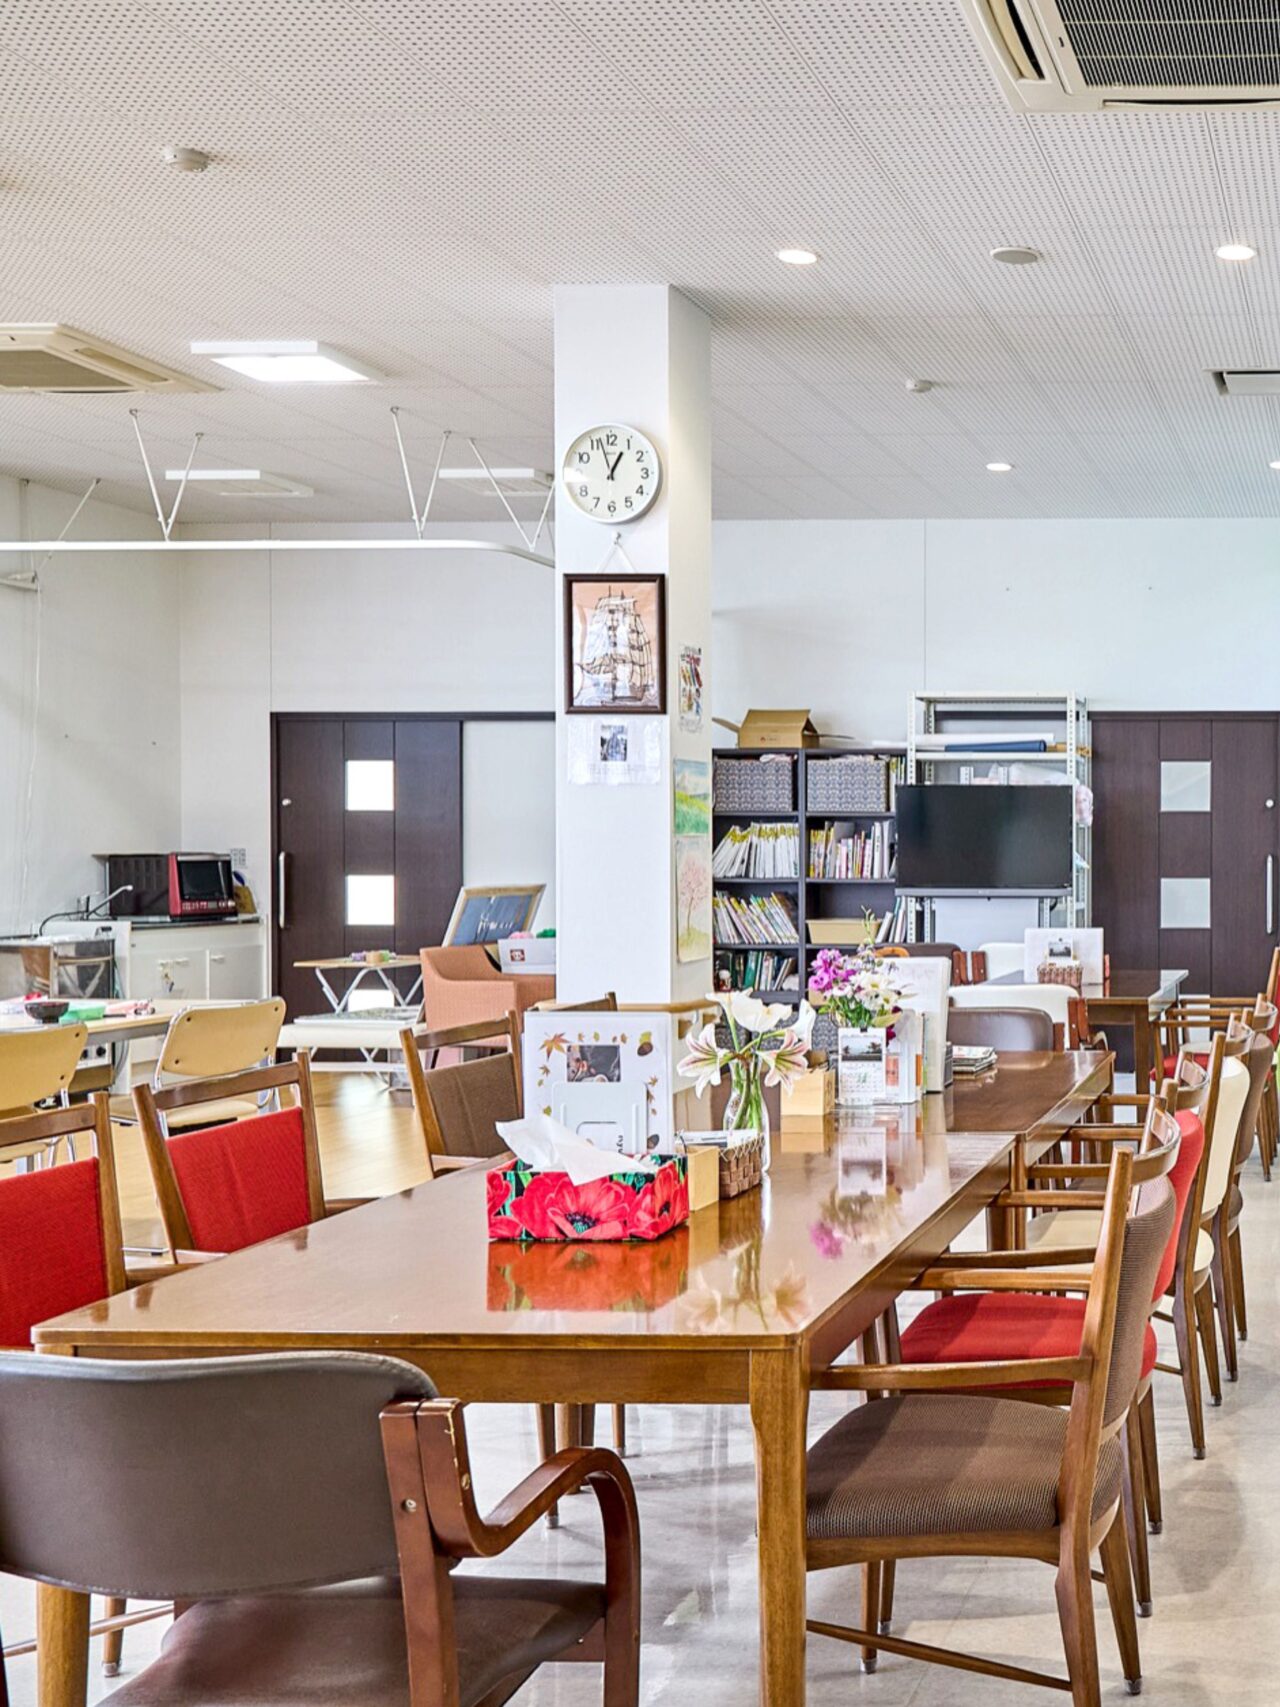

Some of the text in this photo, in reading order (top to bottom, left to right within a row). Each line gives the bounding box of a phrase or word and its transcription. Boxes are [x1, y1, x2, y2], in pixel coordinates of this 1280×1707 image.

[606, 434, 617, 446] 12
[627, 438, 631, 450] 1
[578, 452, 590, 464] 10
[636, 450, 645, 463] 2
[641, 467, 649, 479] 3
[579, 485, 588, 497] 8
[635, 485, 643, 496] 4
[593, 497, 600, 508] 7
[608, 501, 616, 512] 6
[624, 496, 633, 508] 5
